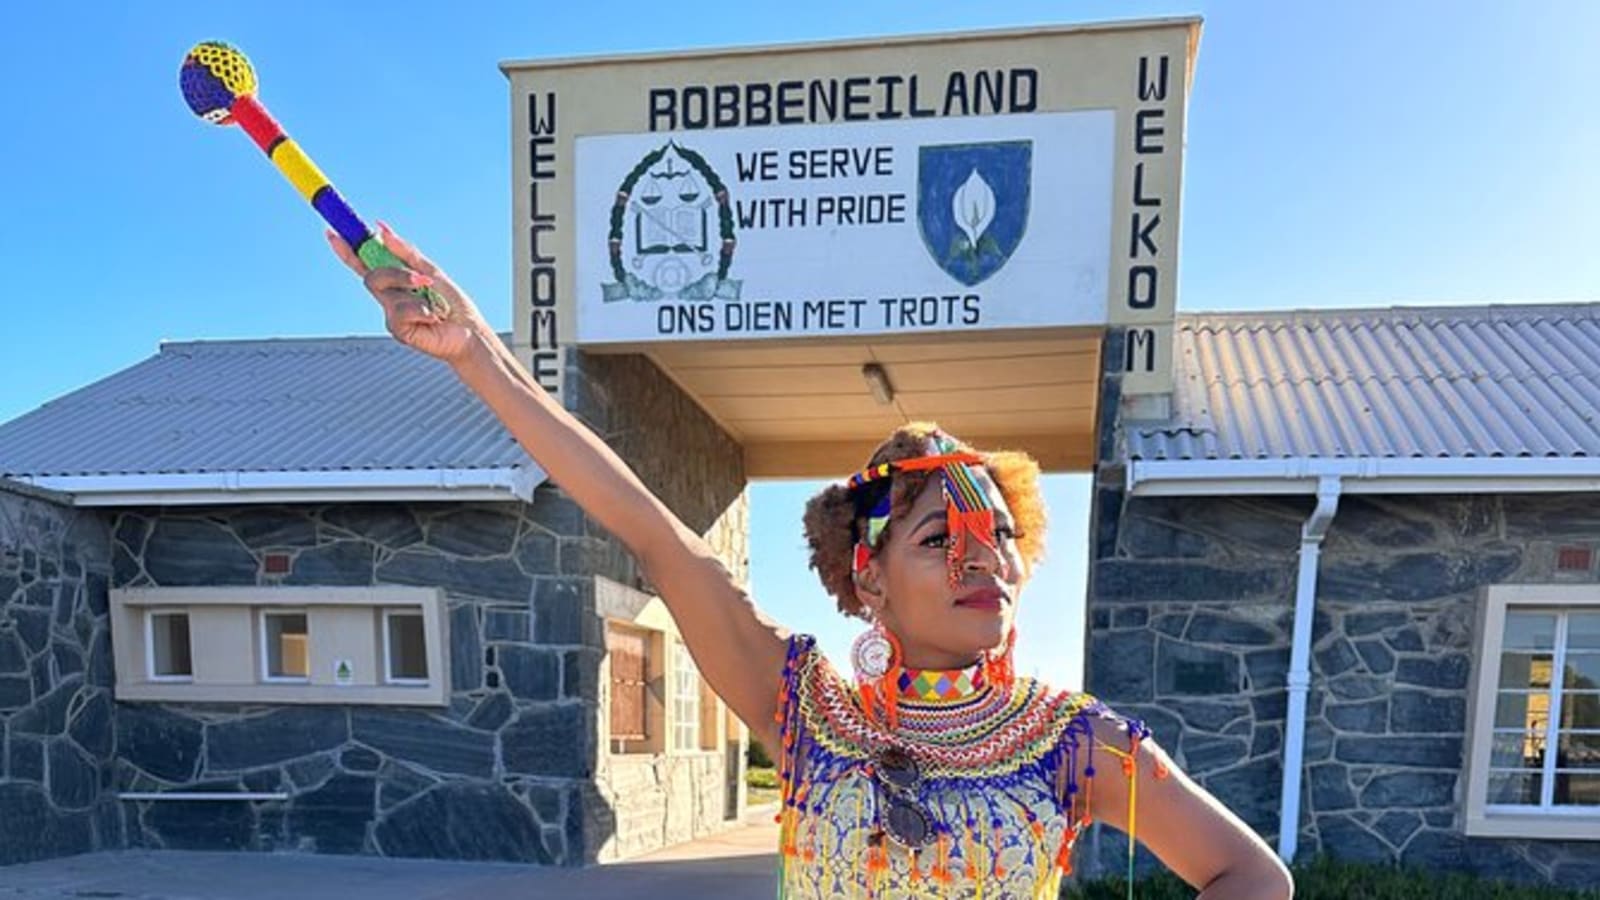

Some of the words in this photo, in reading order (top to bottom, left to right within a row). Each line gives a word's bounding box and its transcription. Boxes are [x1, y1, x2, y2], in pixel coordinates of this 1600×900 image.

[649, 68, 1039, 132] ROBBENEILAND
[736, 151, 778, 182] WE
[789, 147, 893, 179] SERVE
[736, 198, 807, 229] WITH
[817, 194, 906, 226] PRIDE
[1125, 55, 1170, 374] WELKOM
[528, 92, 558, 393] WELCOME
[658, 305, 714, 333] ONS
[725, 302, 792, 331] DIEN
[803, 300, 867, 329] MET
[879, 295, 980, 326] TROTS
